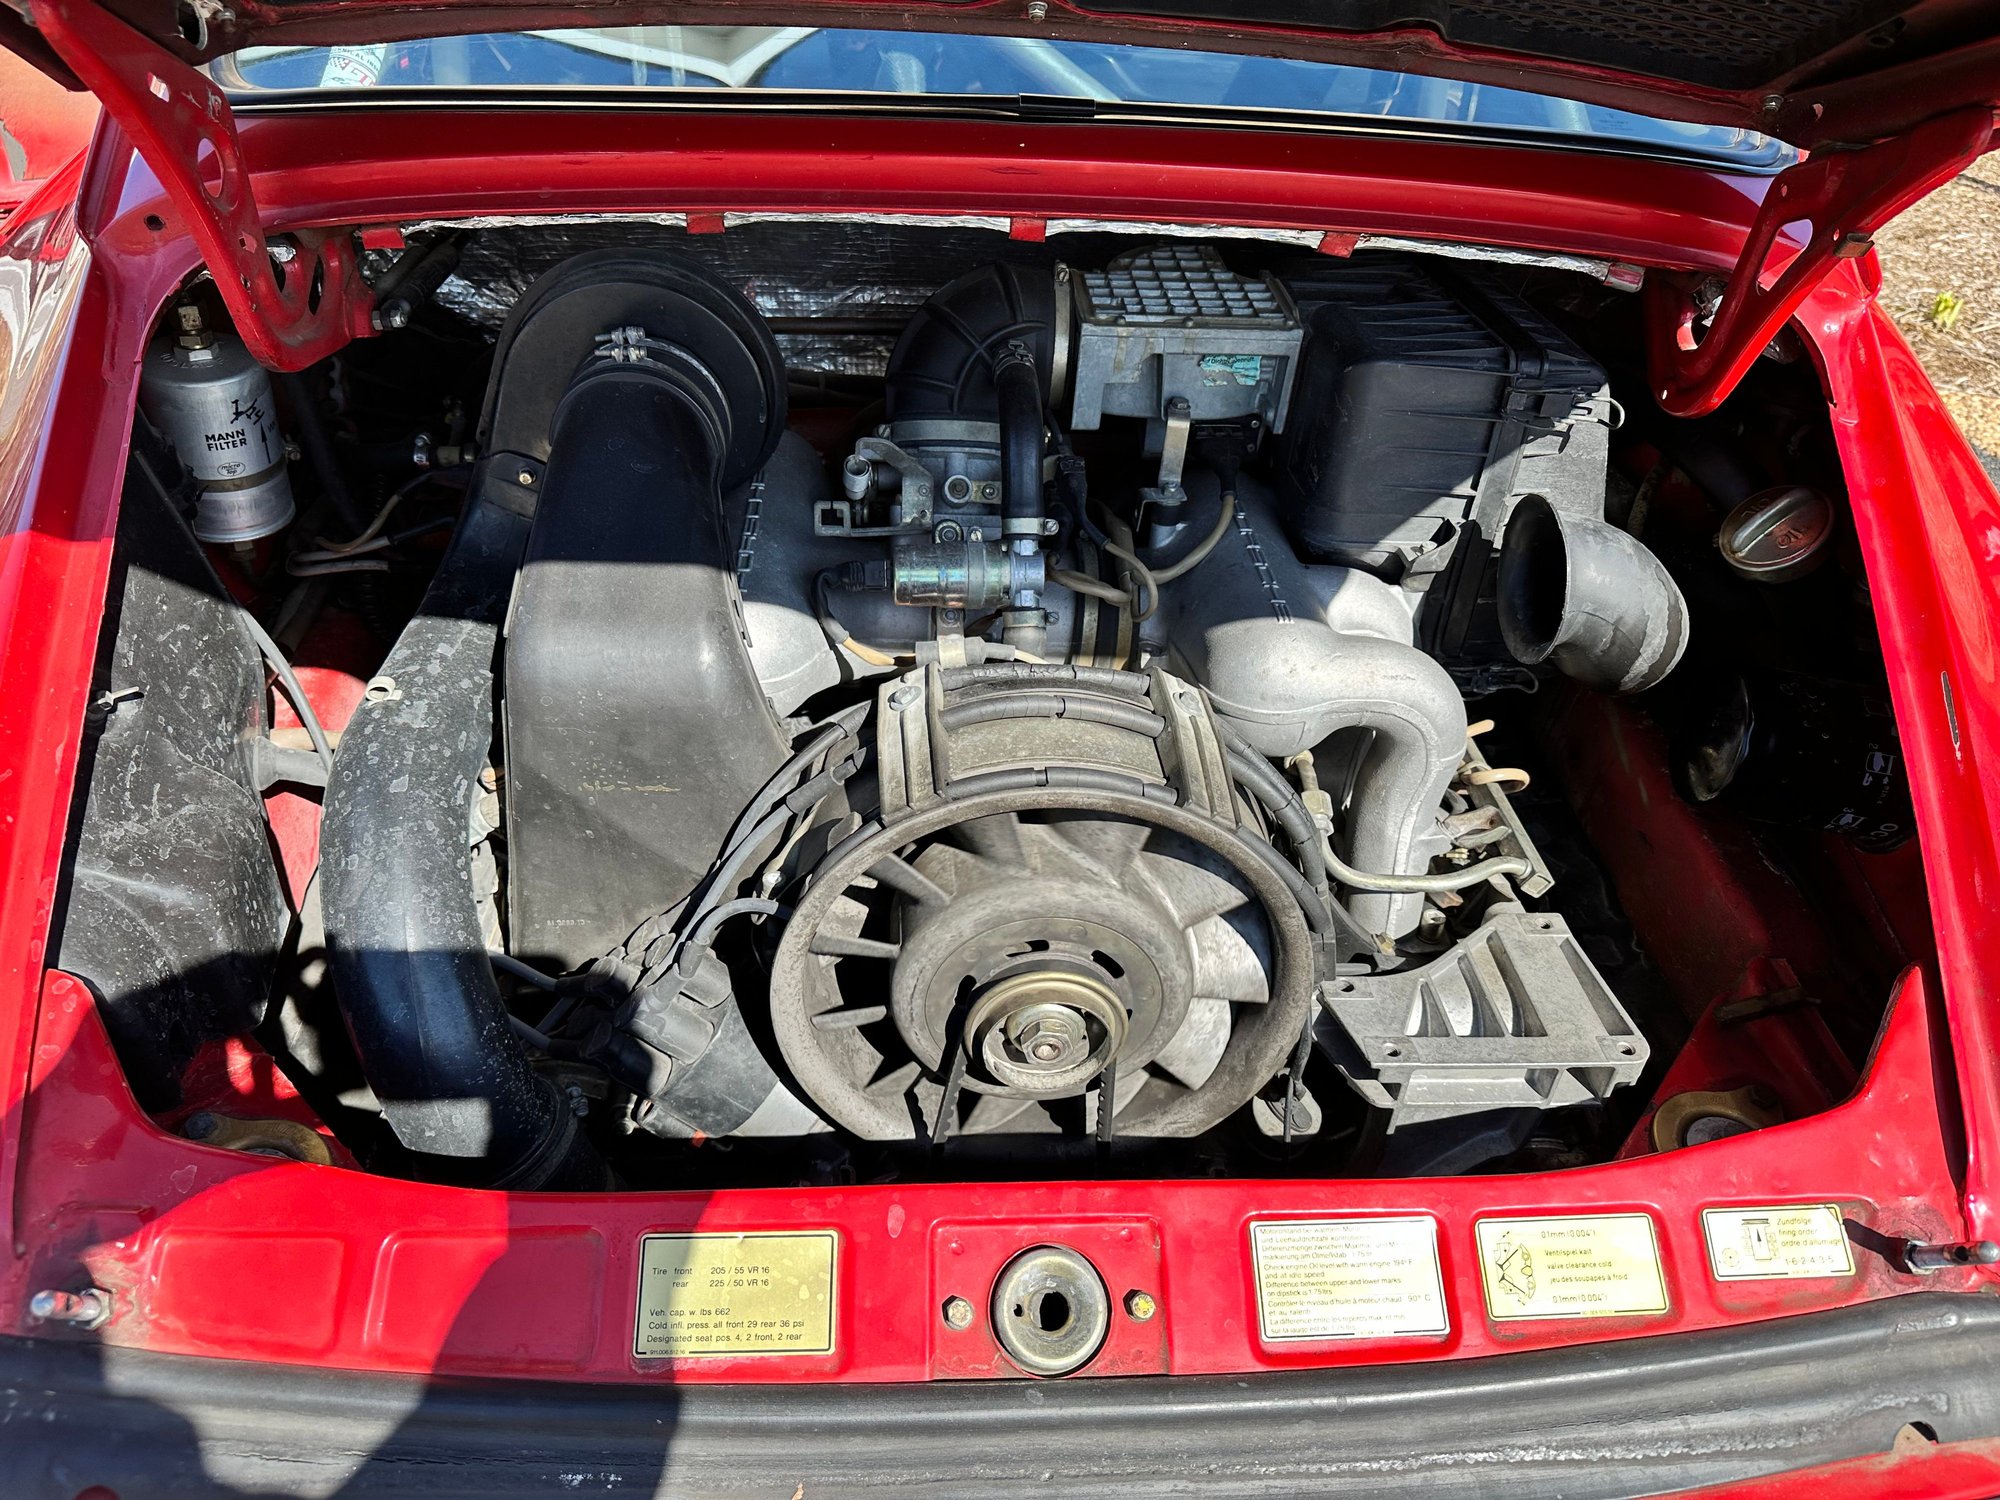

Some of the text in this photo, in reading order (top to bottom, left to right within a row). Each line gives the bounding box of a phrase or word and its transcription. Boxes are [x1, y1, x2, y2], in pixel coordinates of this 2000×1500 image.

[205, 429, 245, 442] MANN
[207, 438, 247, 451] FILTER
[1547, 1260, 1612, 1270] valve clearance cold
[653, 1267, 667, 1275] Tire
[674, 1267, 692, 1275] front
[710, 1266, 726, 1274] 205
[734, 1266, 745, 1274] 55
[747, 1266, 759, 1274] VR
[761, 1266, 770, 1274] 16
[709, 1279, 725, 1287] 225
[733, 1279, 744, 1287] 50
[746, 1279, 759, 1287] VR
[761, 1279, 770, 1287] 16
[1265, 1281, 1299, 1289] Difference
[1300, 1280, 1328, 1288] between
[1277, 1289, 1301, 1298] dipstick
[650, 1309, 667, 1317] Veh.
[669, 1309, 686, 1318] cap.
[700, 1308, 712, 1316] lbs
[715, 1308, 731, 1316] 662
[648, 1322, 668, 1330] Cold
[686, 1322, 711, 1331] press.
[747, 1320, 758, 1328] 29
[779, 1320, 790, 1328] 36
[792, 1320, 805, 1329] psi
[647, 1334, 693, 1344] Designated
[695, 1334, 713, 1342] seat
[715, 1334, 732, 1344] pos.
[746, 1333, 752, 1341] 2
[754, 1332, 775, 1342] front,
[777, 1333, 783, 1341] 2
[786, 1333, 802, 1341] rear
